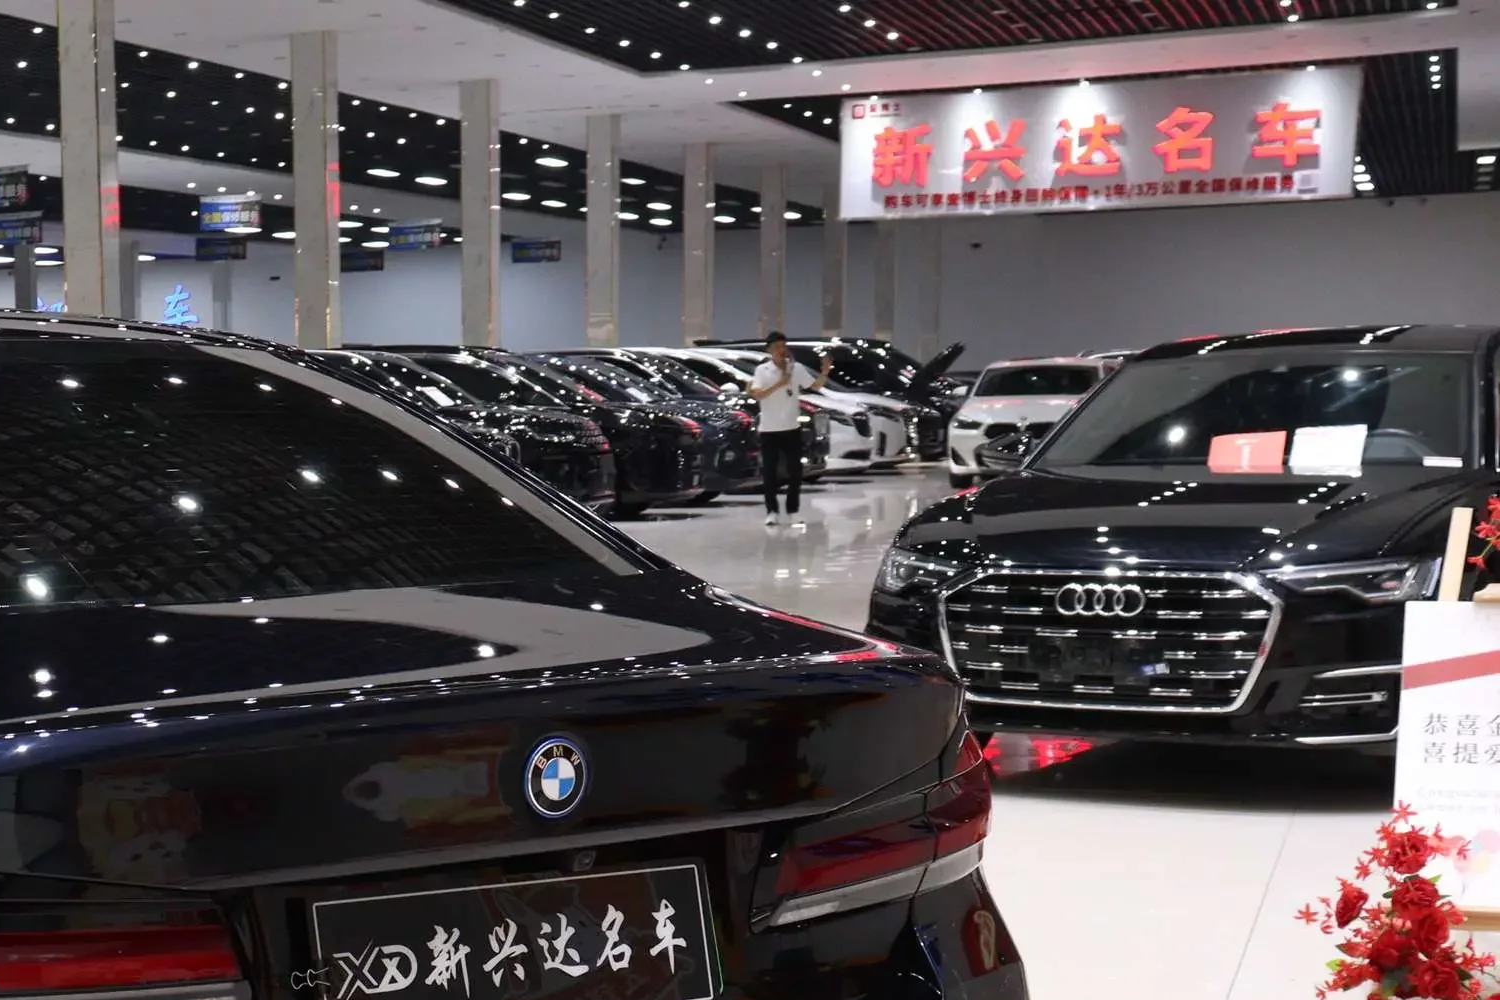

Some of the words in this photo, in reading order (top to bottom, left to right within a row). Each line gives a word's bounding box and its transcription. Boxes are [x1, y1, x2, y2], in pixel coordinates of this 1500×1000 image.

[872, 101, 1322, 188] 新兴达名车
[536, 746, 580, 769] BMW
[425, 899, 688, 999] 新兴达名车
